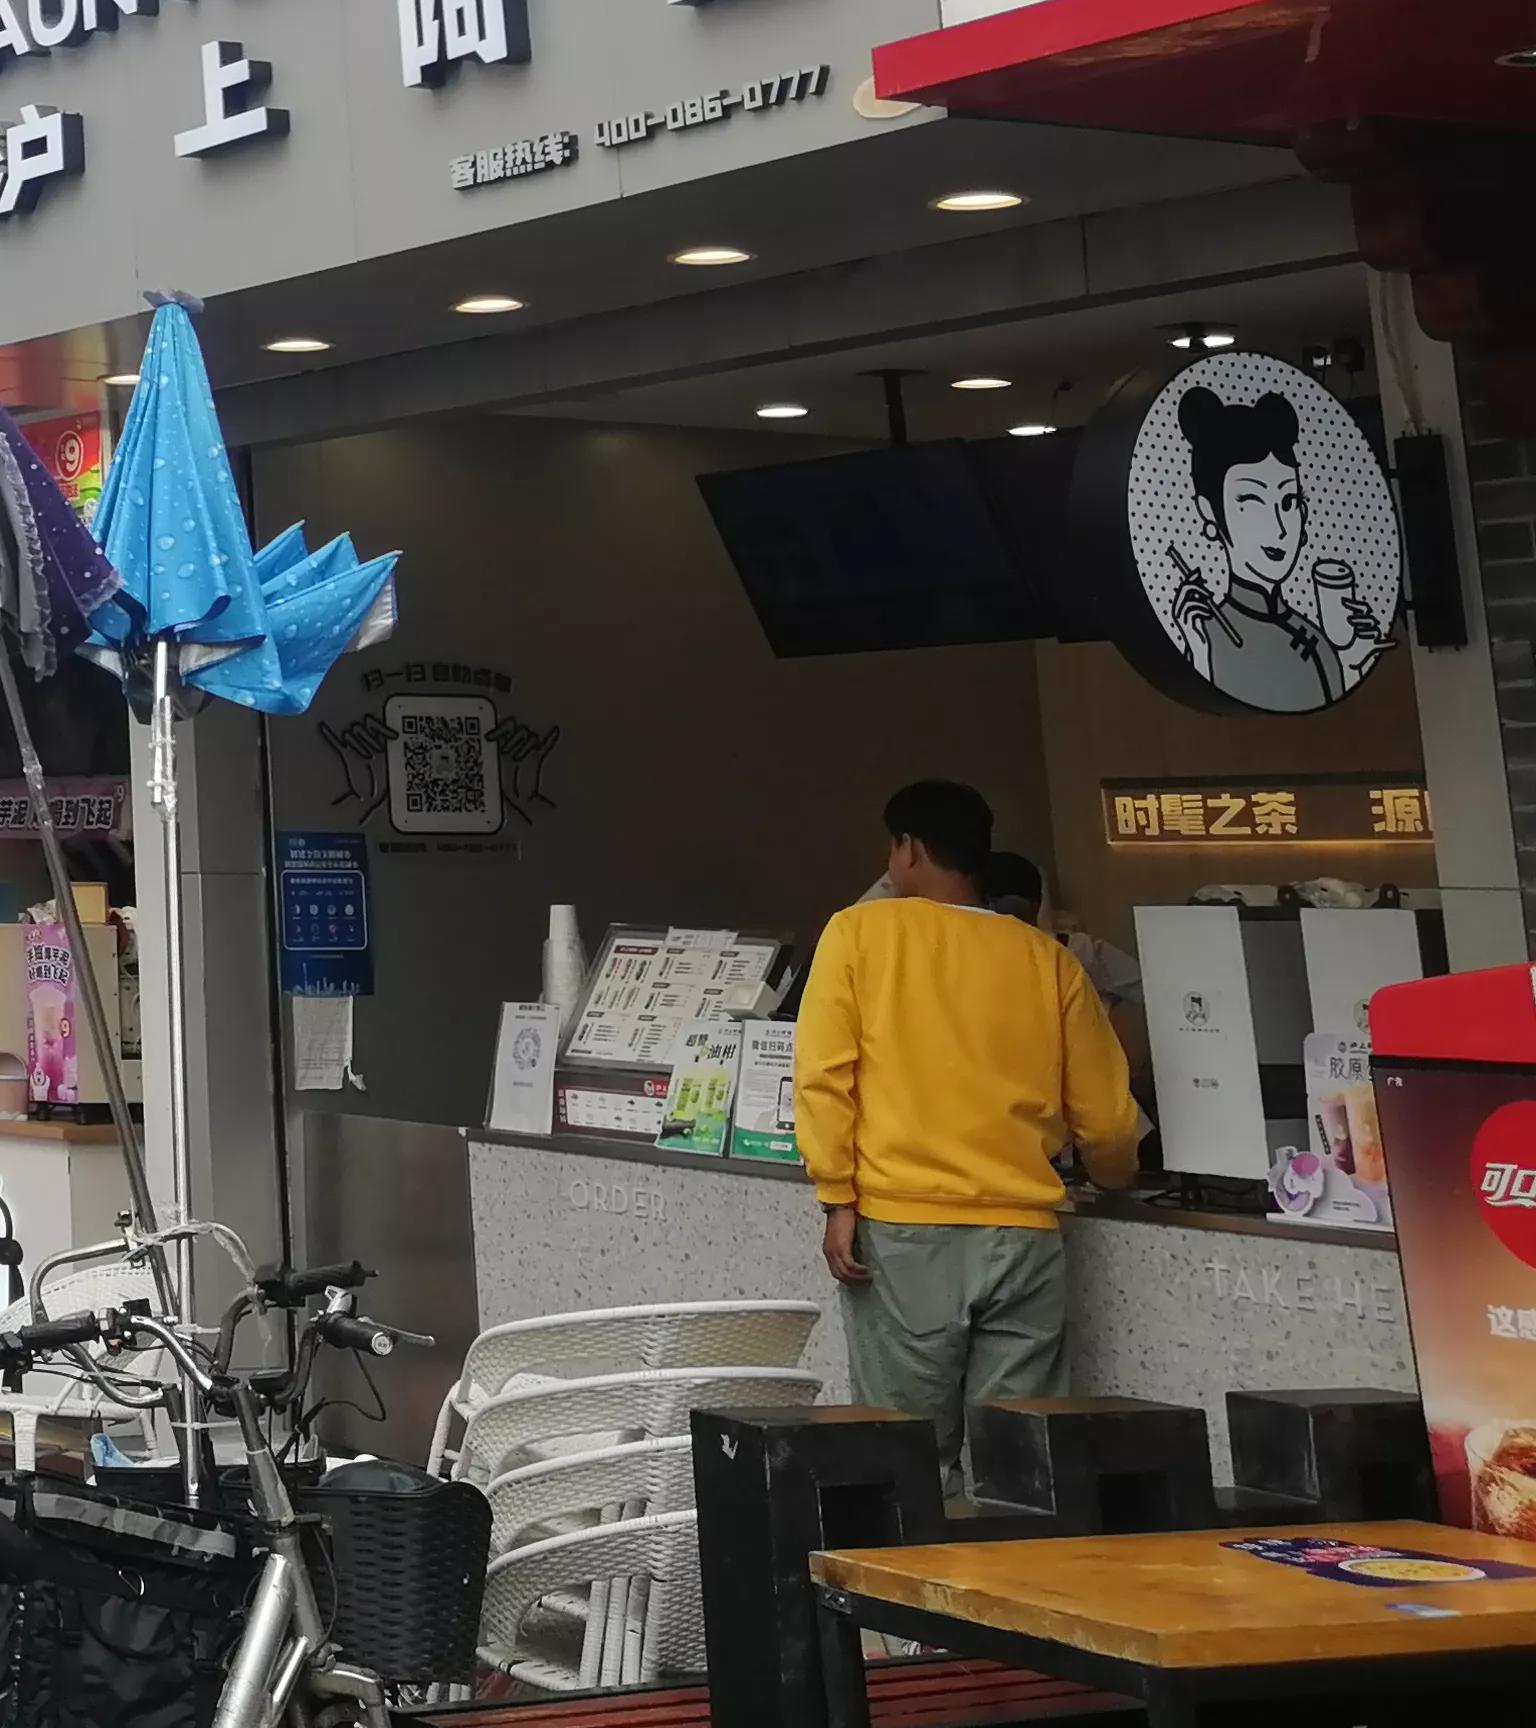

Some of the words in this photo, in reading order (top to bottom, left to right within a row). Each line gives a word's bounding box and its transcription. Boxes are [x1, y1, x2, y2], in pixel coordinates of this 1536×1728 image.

[593, 63, 826, 148] 400-086-0777
[1114, 792, 1299, 838] 时髦之茶
[1369, 789, 1433, 832] 源
[569, 1180, 667, 1223] ORDER
[1205, 1259, 1317, 1314] TAKE
